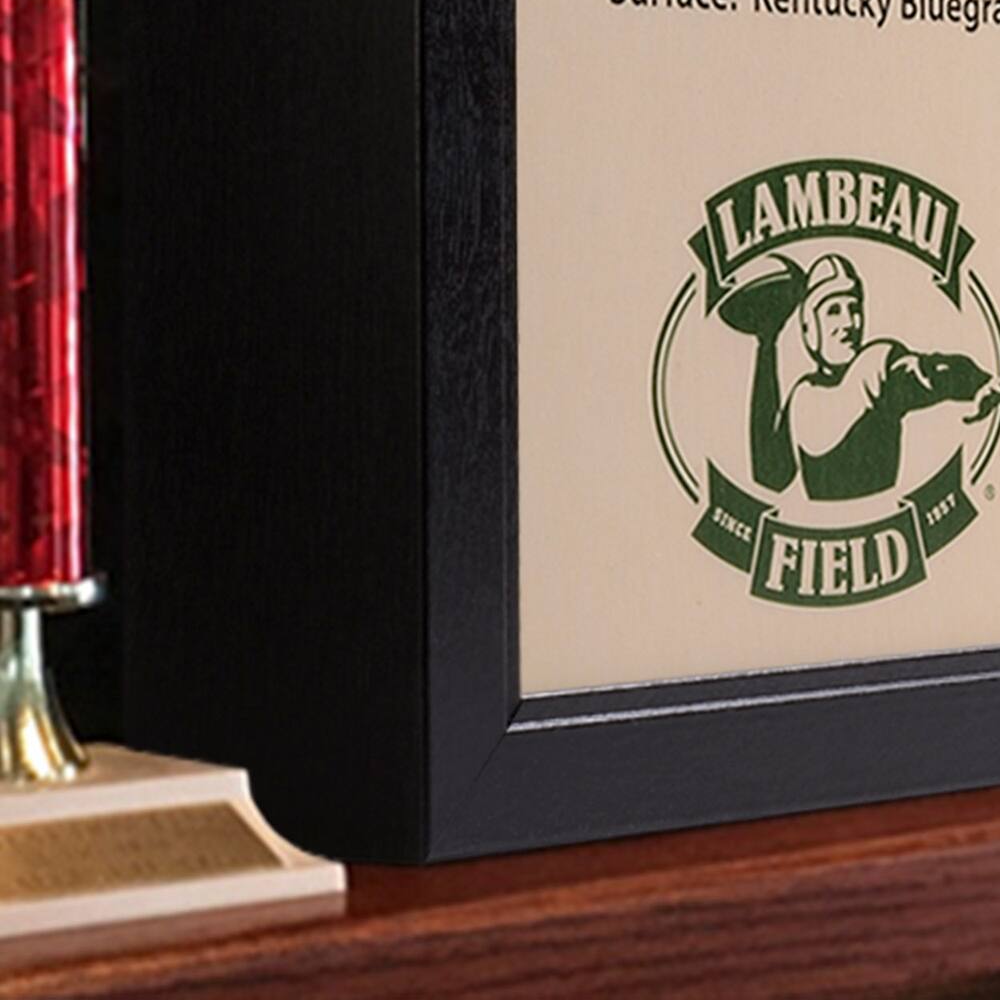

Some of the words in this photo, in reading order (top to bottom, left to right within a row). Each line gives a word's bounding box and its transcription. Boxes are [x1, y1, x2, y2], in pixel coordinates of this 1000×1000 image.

[716, 169, 949, 262] LAMBEAU
[710, 506, 753, 543] SINCE
[765, 528, 910, 596] FIELD
